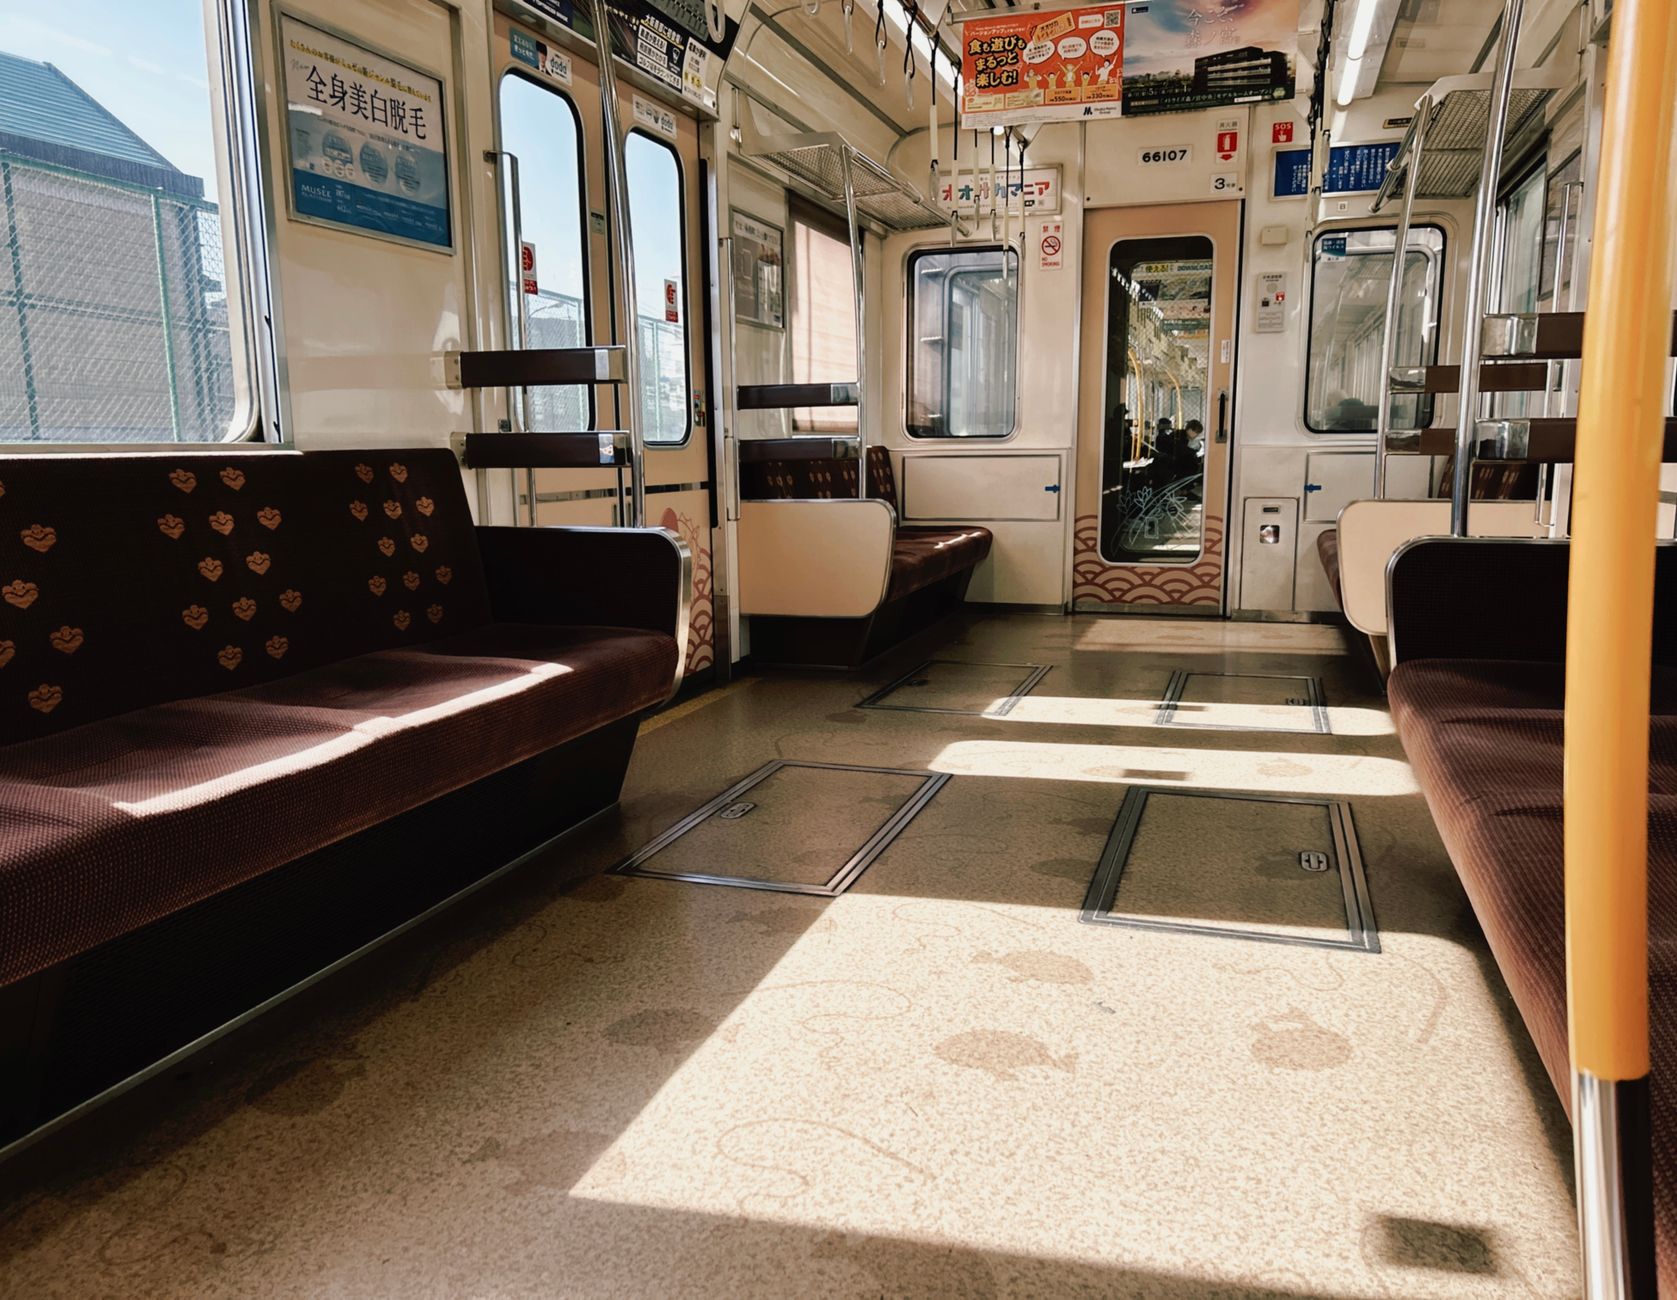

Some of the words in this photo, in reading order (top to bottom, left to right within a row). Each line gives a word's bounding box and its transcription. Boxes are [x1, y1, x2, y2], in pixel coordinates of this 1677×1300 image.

[969, 36, 1027, 55] 食も遊びも
[975, 52, 1018, 71] まるっと
[976, 70, 1018, 87] 楽しむ!
[306, 65, 426, 140] 全身美白脱毛
[1274, 123, 1292, 131] SOS
[1142, 149, 1188, 163] 66107
